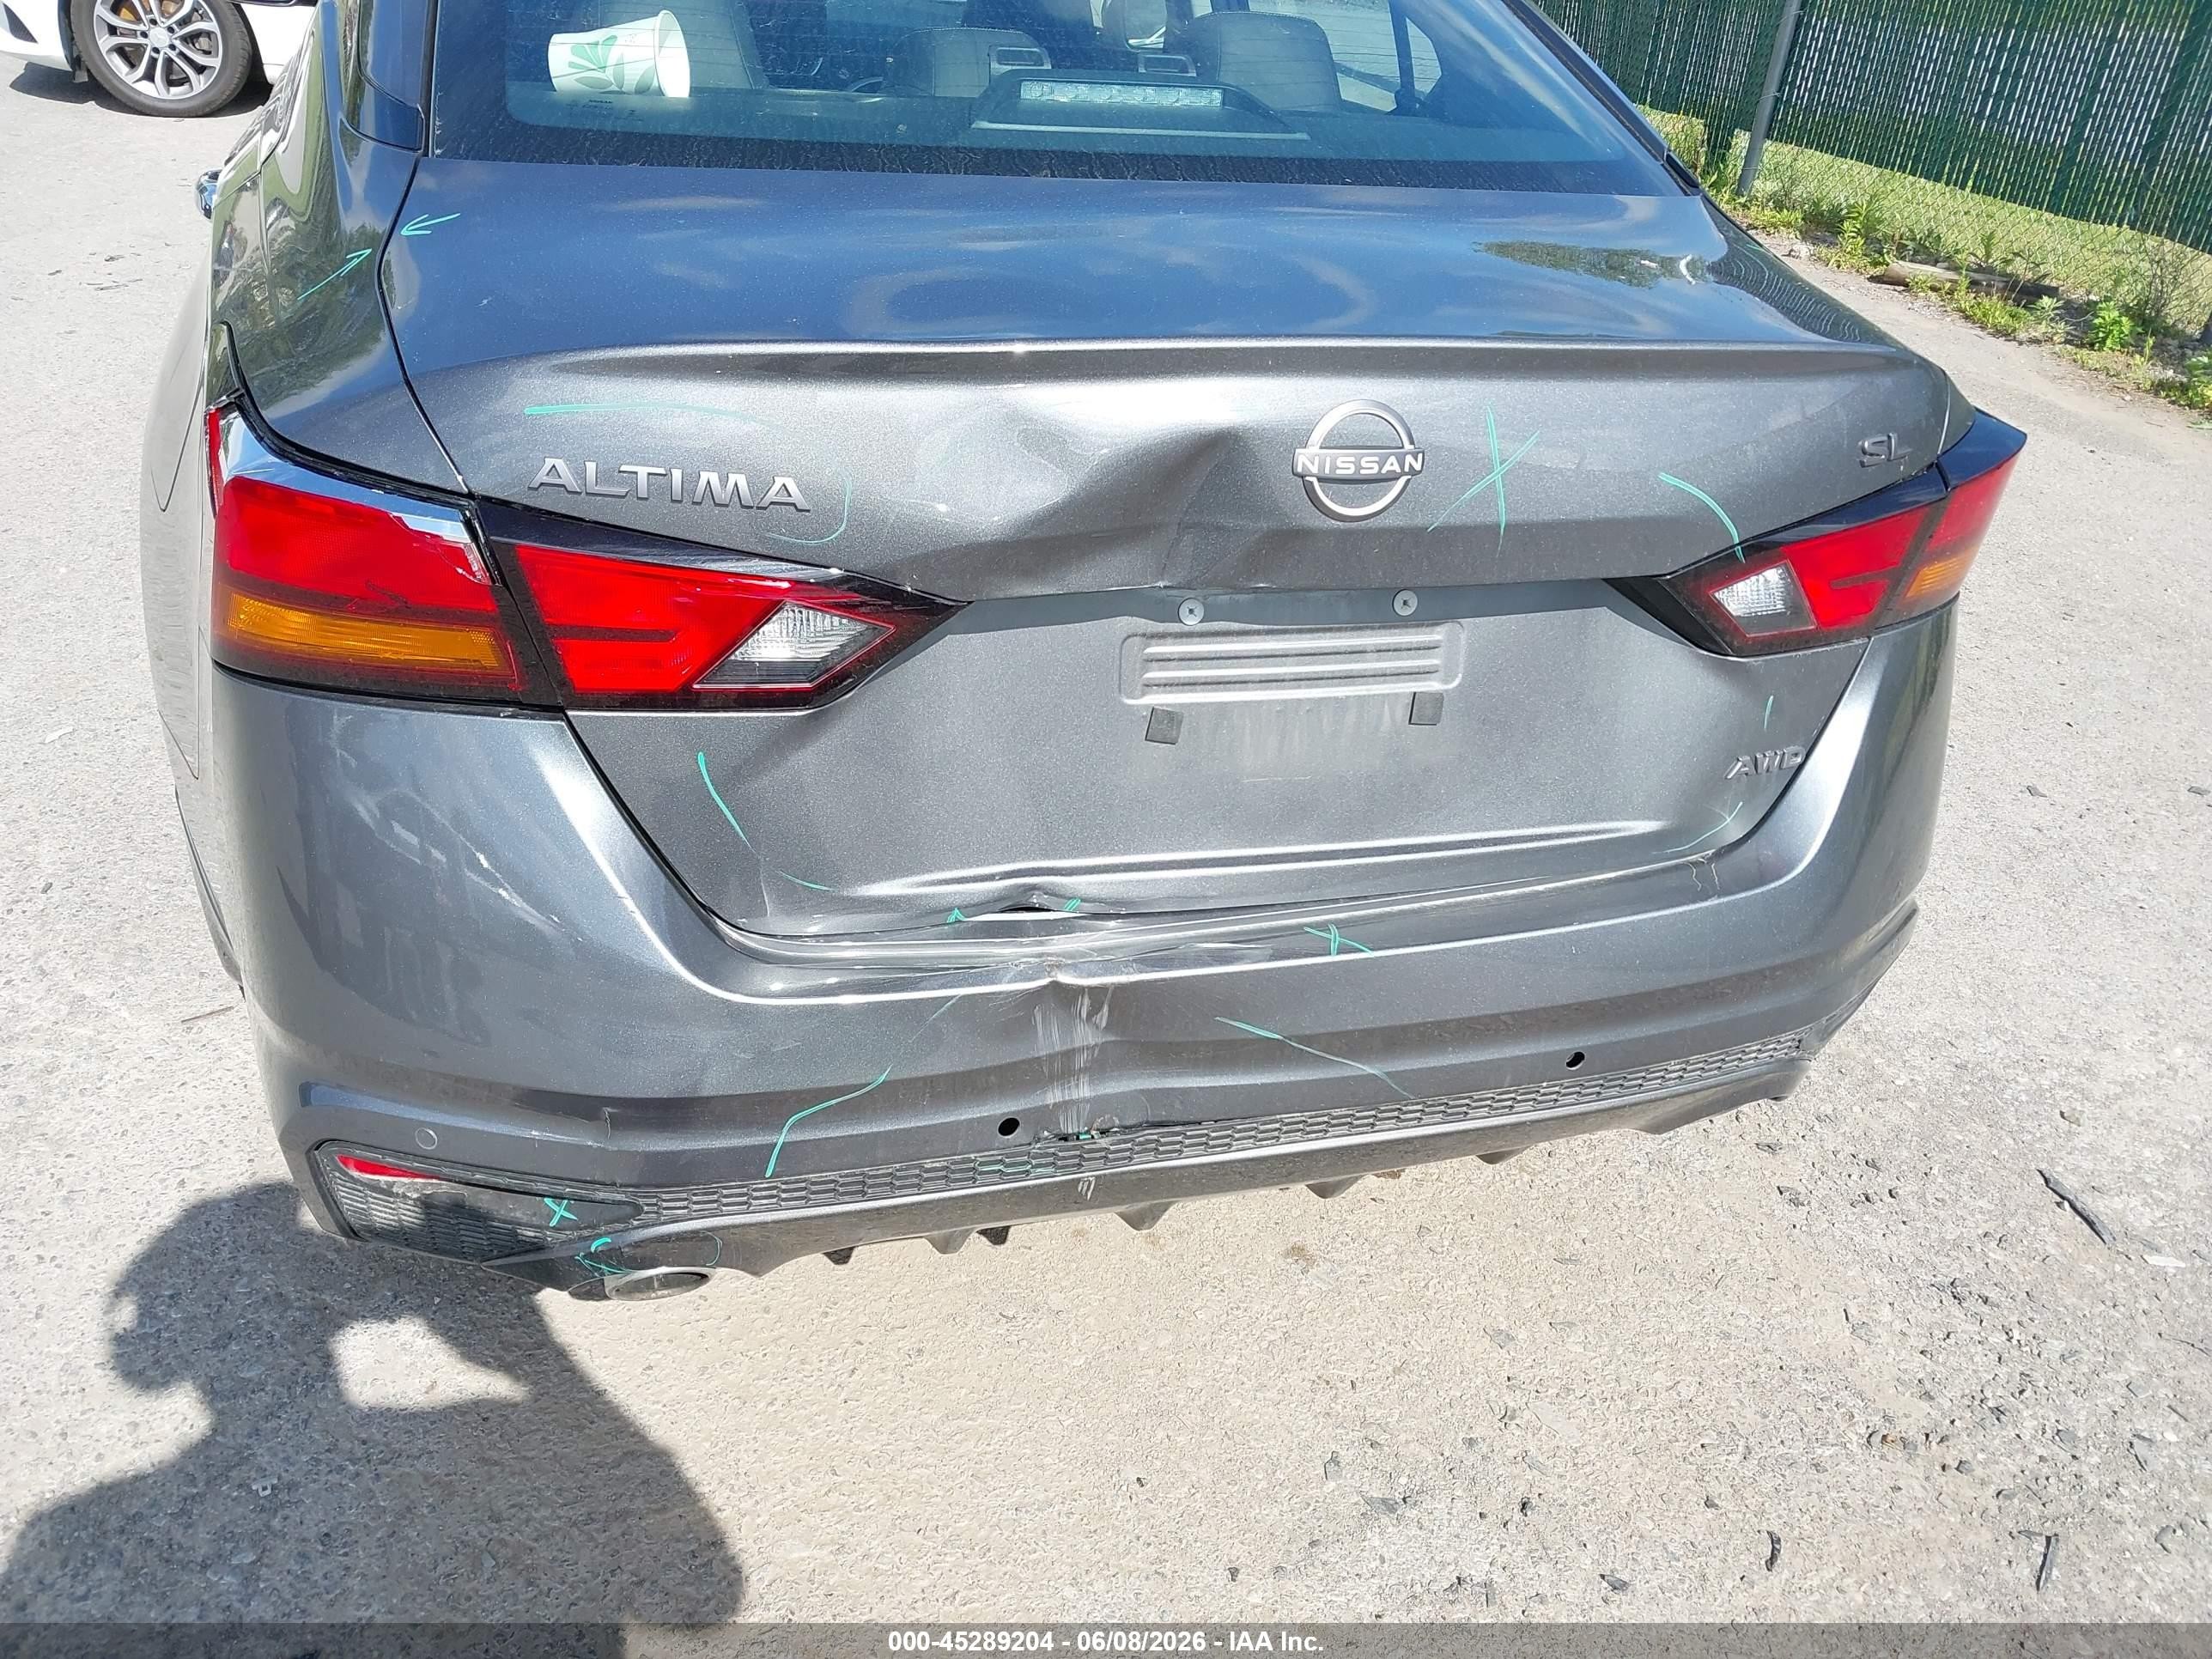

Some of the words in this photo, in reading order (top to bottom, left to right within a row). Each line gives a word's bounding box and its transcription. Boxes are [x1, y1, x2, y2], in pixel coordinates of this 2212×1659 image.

[1297, 453, 1423, 475] NISSAN
[1858, 433, 1912, 468] SL
[527, 457, 811, 512] ALTIMA
[1723, 745, 1805, 780] AWD
